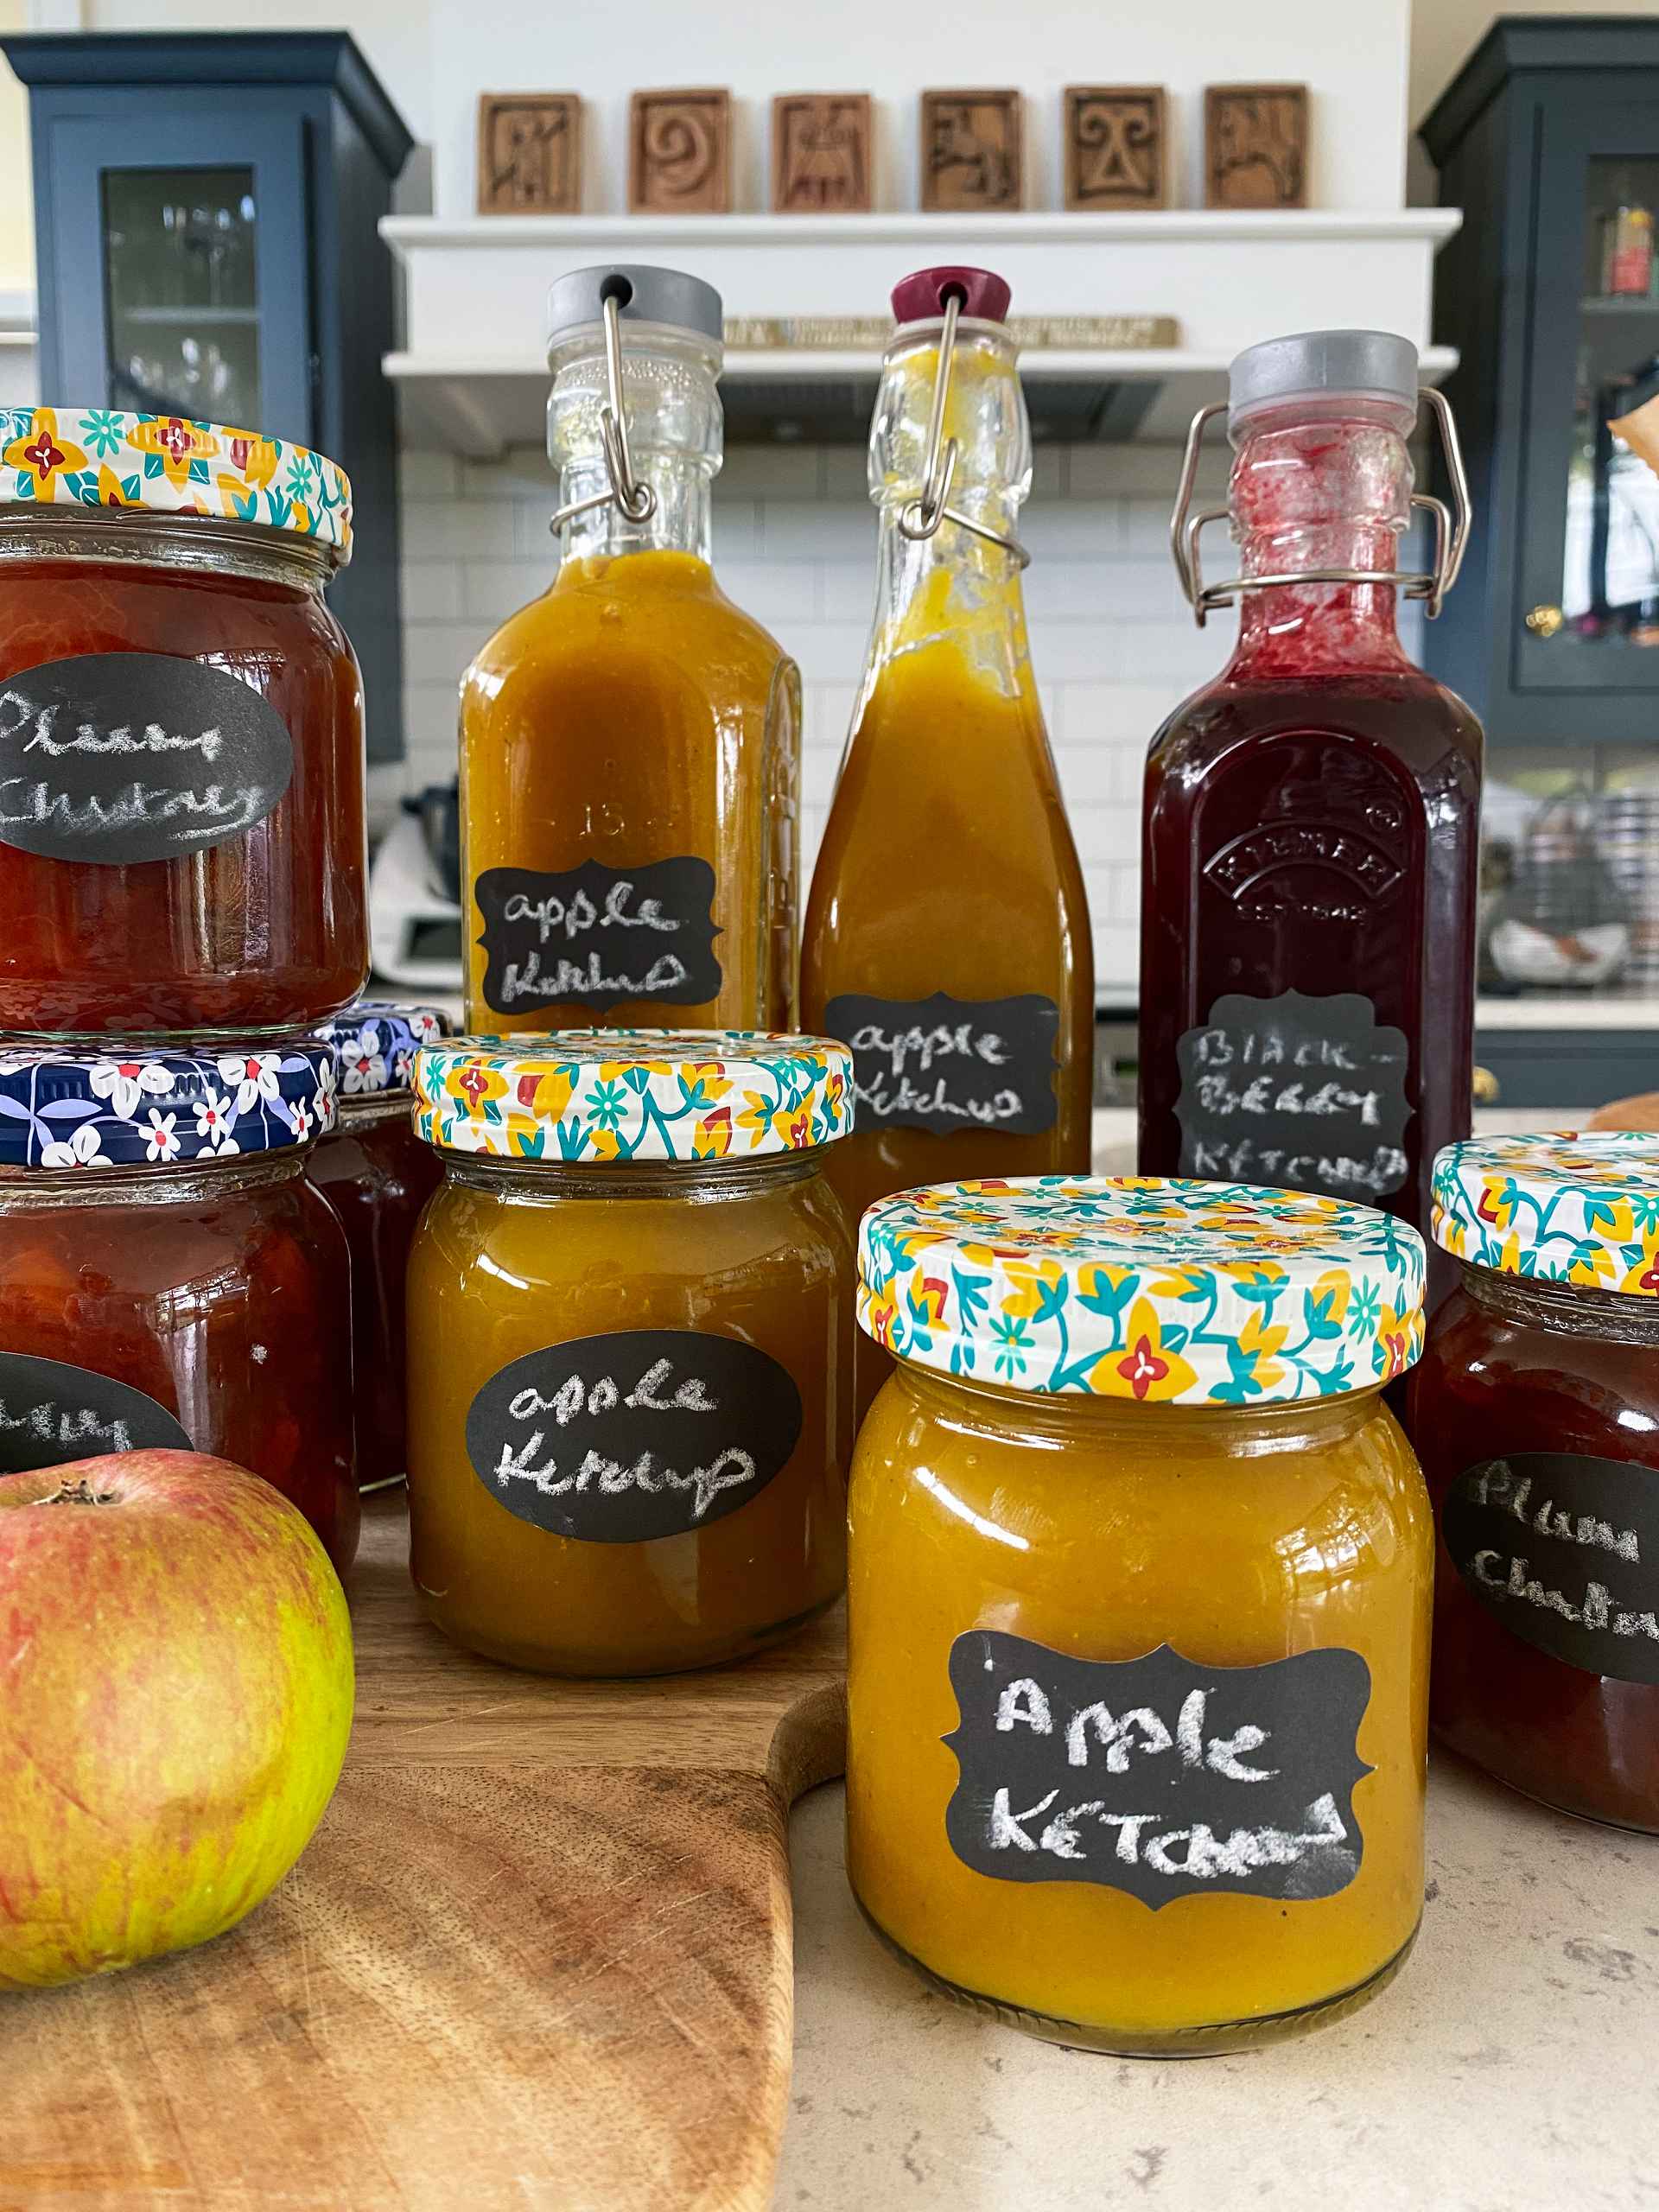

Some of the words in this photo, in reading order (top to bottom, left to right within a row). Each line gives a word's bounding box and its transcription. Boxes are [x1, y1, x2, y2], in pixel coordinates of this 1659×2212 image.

[504, 881, 682, 943] apple
[850, 1024, 1014, 1077] apple
[508, 1357, 721, 1427] apple
[994, 1676, 1281, 1783] Apple
